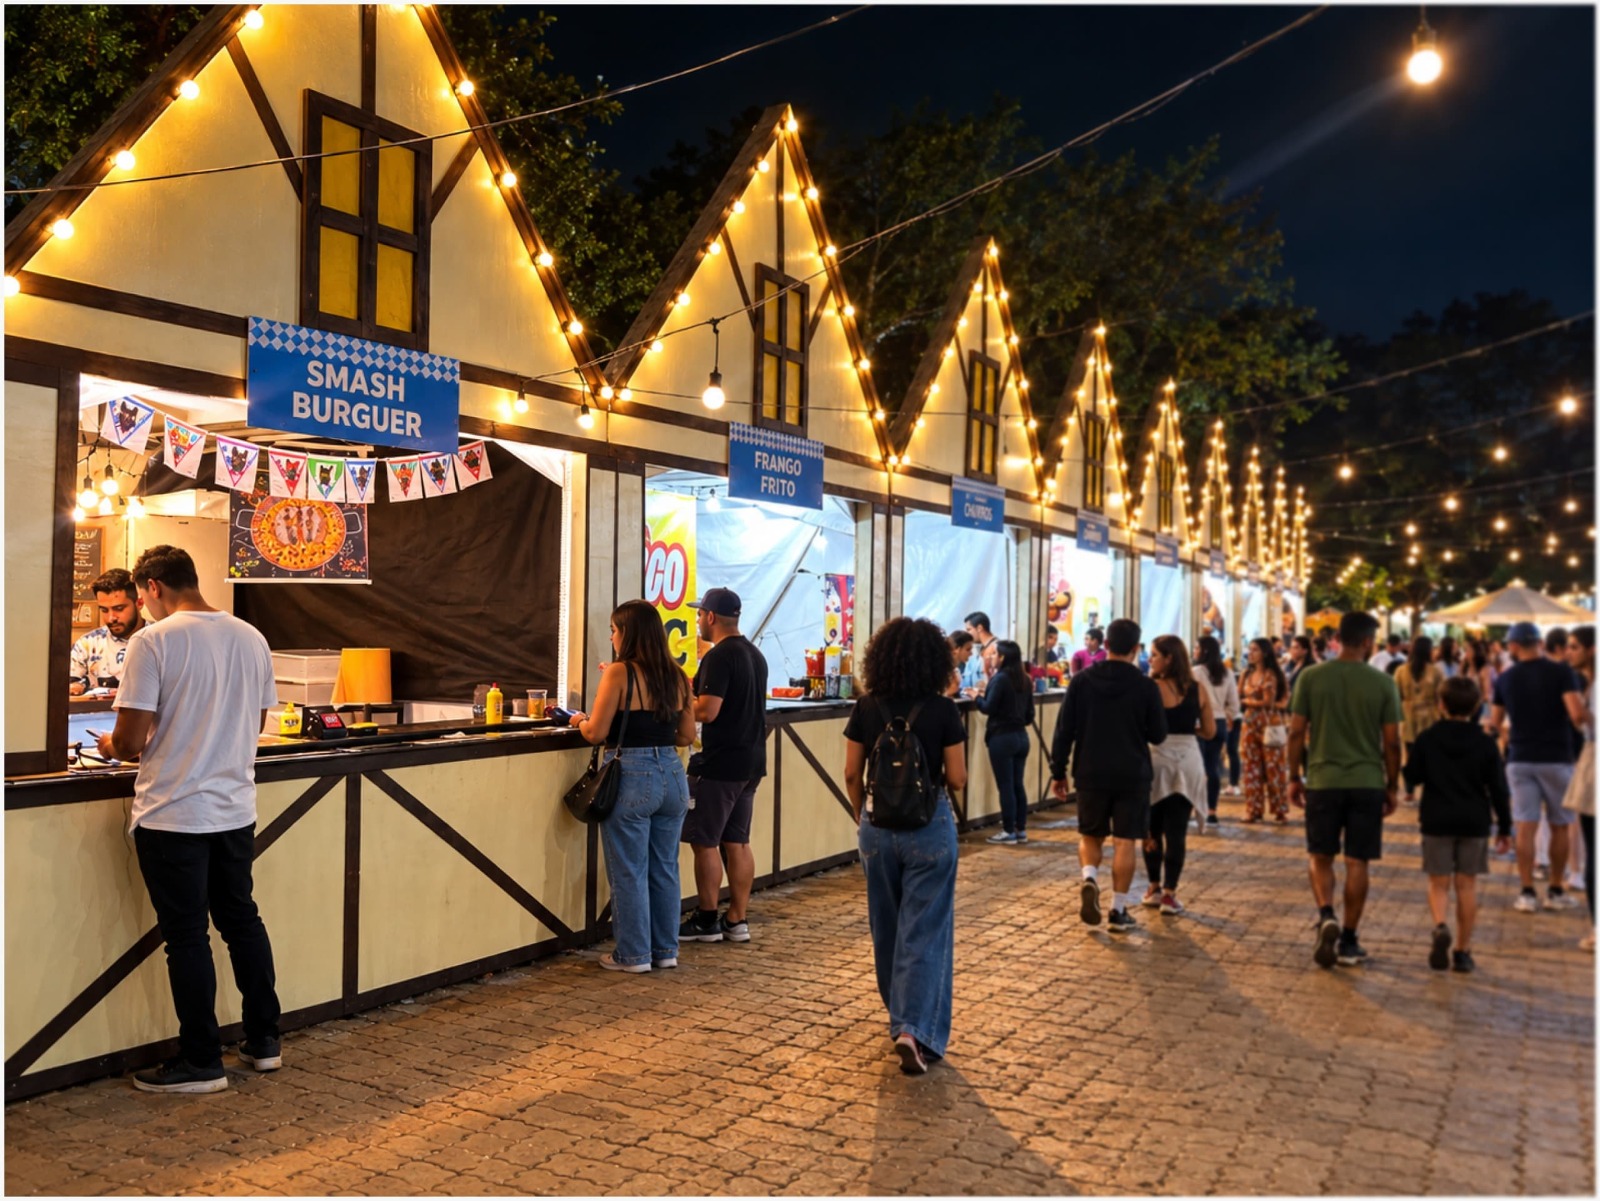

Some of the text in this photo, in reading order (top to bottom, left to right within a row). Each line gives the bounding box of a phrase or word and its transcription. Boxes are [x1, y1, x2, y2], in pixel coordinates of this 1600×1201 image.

[307, 360, 405, 402] SMASH
[292, 391, 422, 438] BURGUER
[755, 451, 802, 476] FRANGO
[761, 476, 796, 497] FRITO
[645, 543, 684, 607] CO
